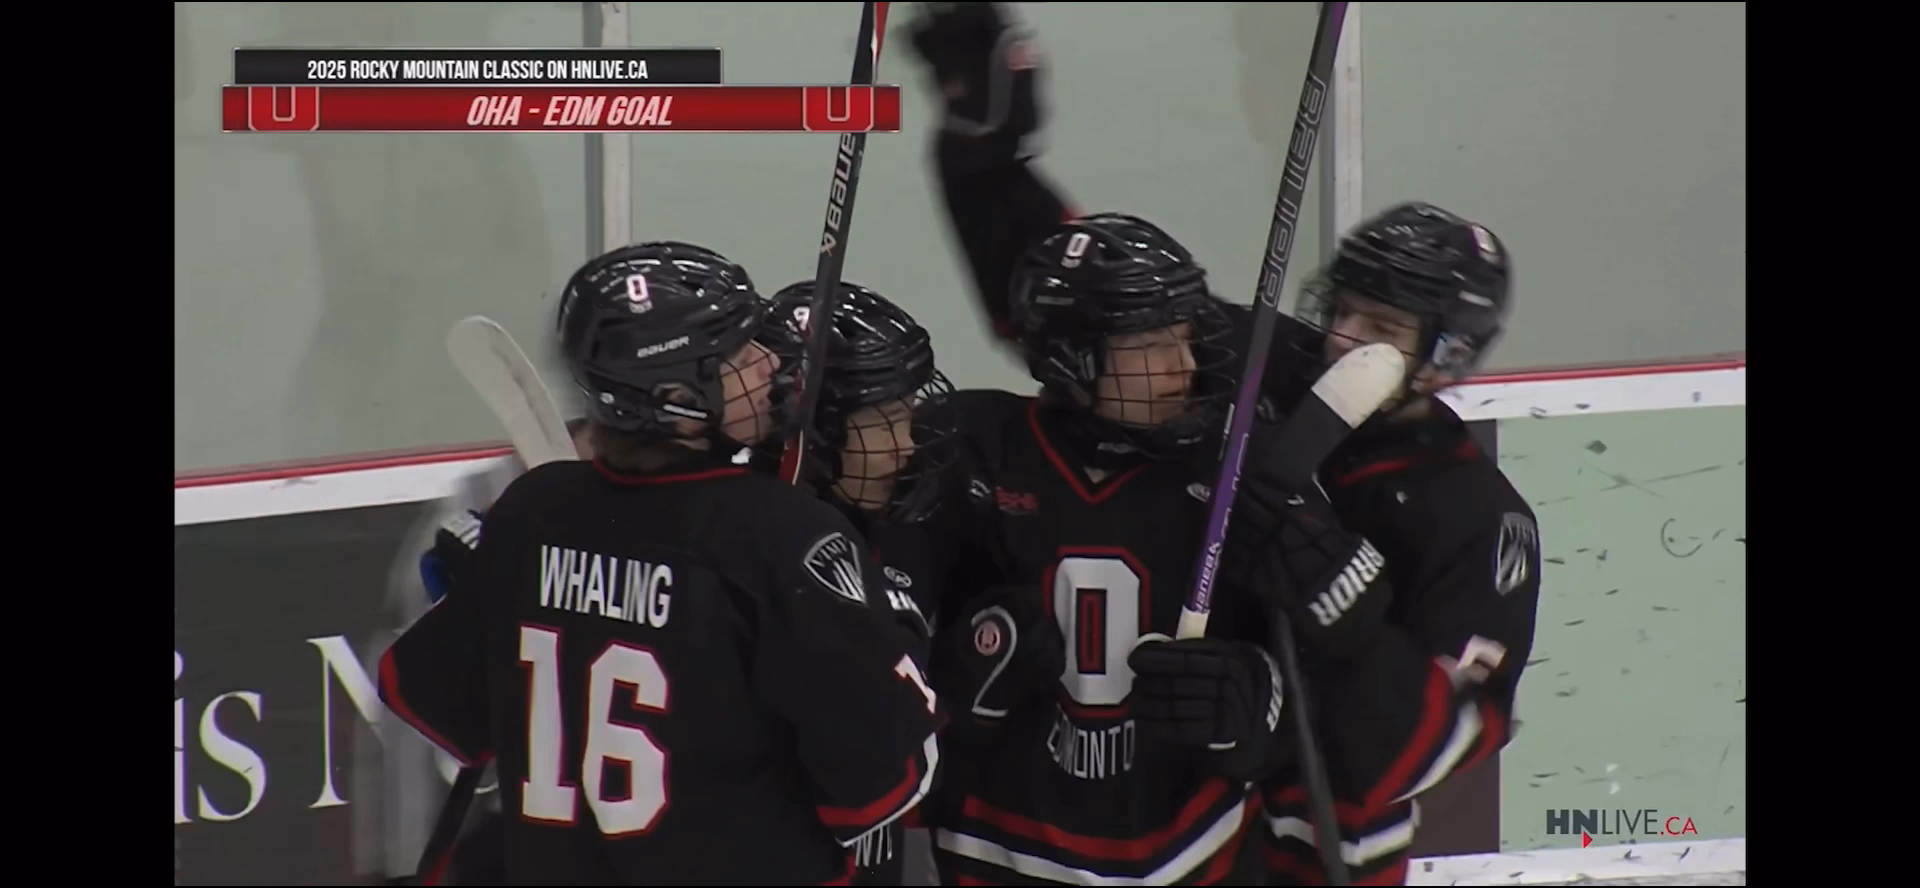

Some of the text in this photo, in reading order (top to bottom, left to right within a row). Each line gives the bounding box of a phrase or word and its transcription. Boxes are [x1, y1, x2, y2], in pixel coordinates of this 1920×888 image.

[826, 131, 857, 233] BAUE
[1260, 71, 1328, 308] BAUER
[539, 544, 674, 629] WHALING
[519, 624, 669, 837] 16
